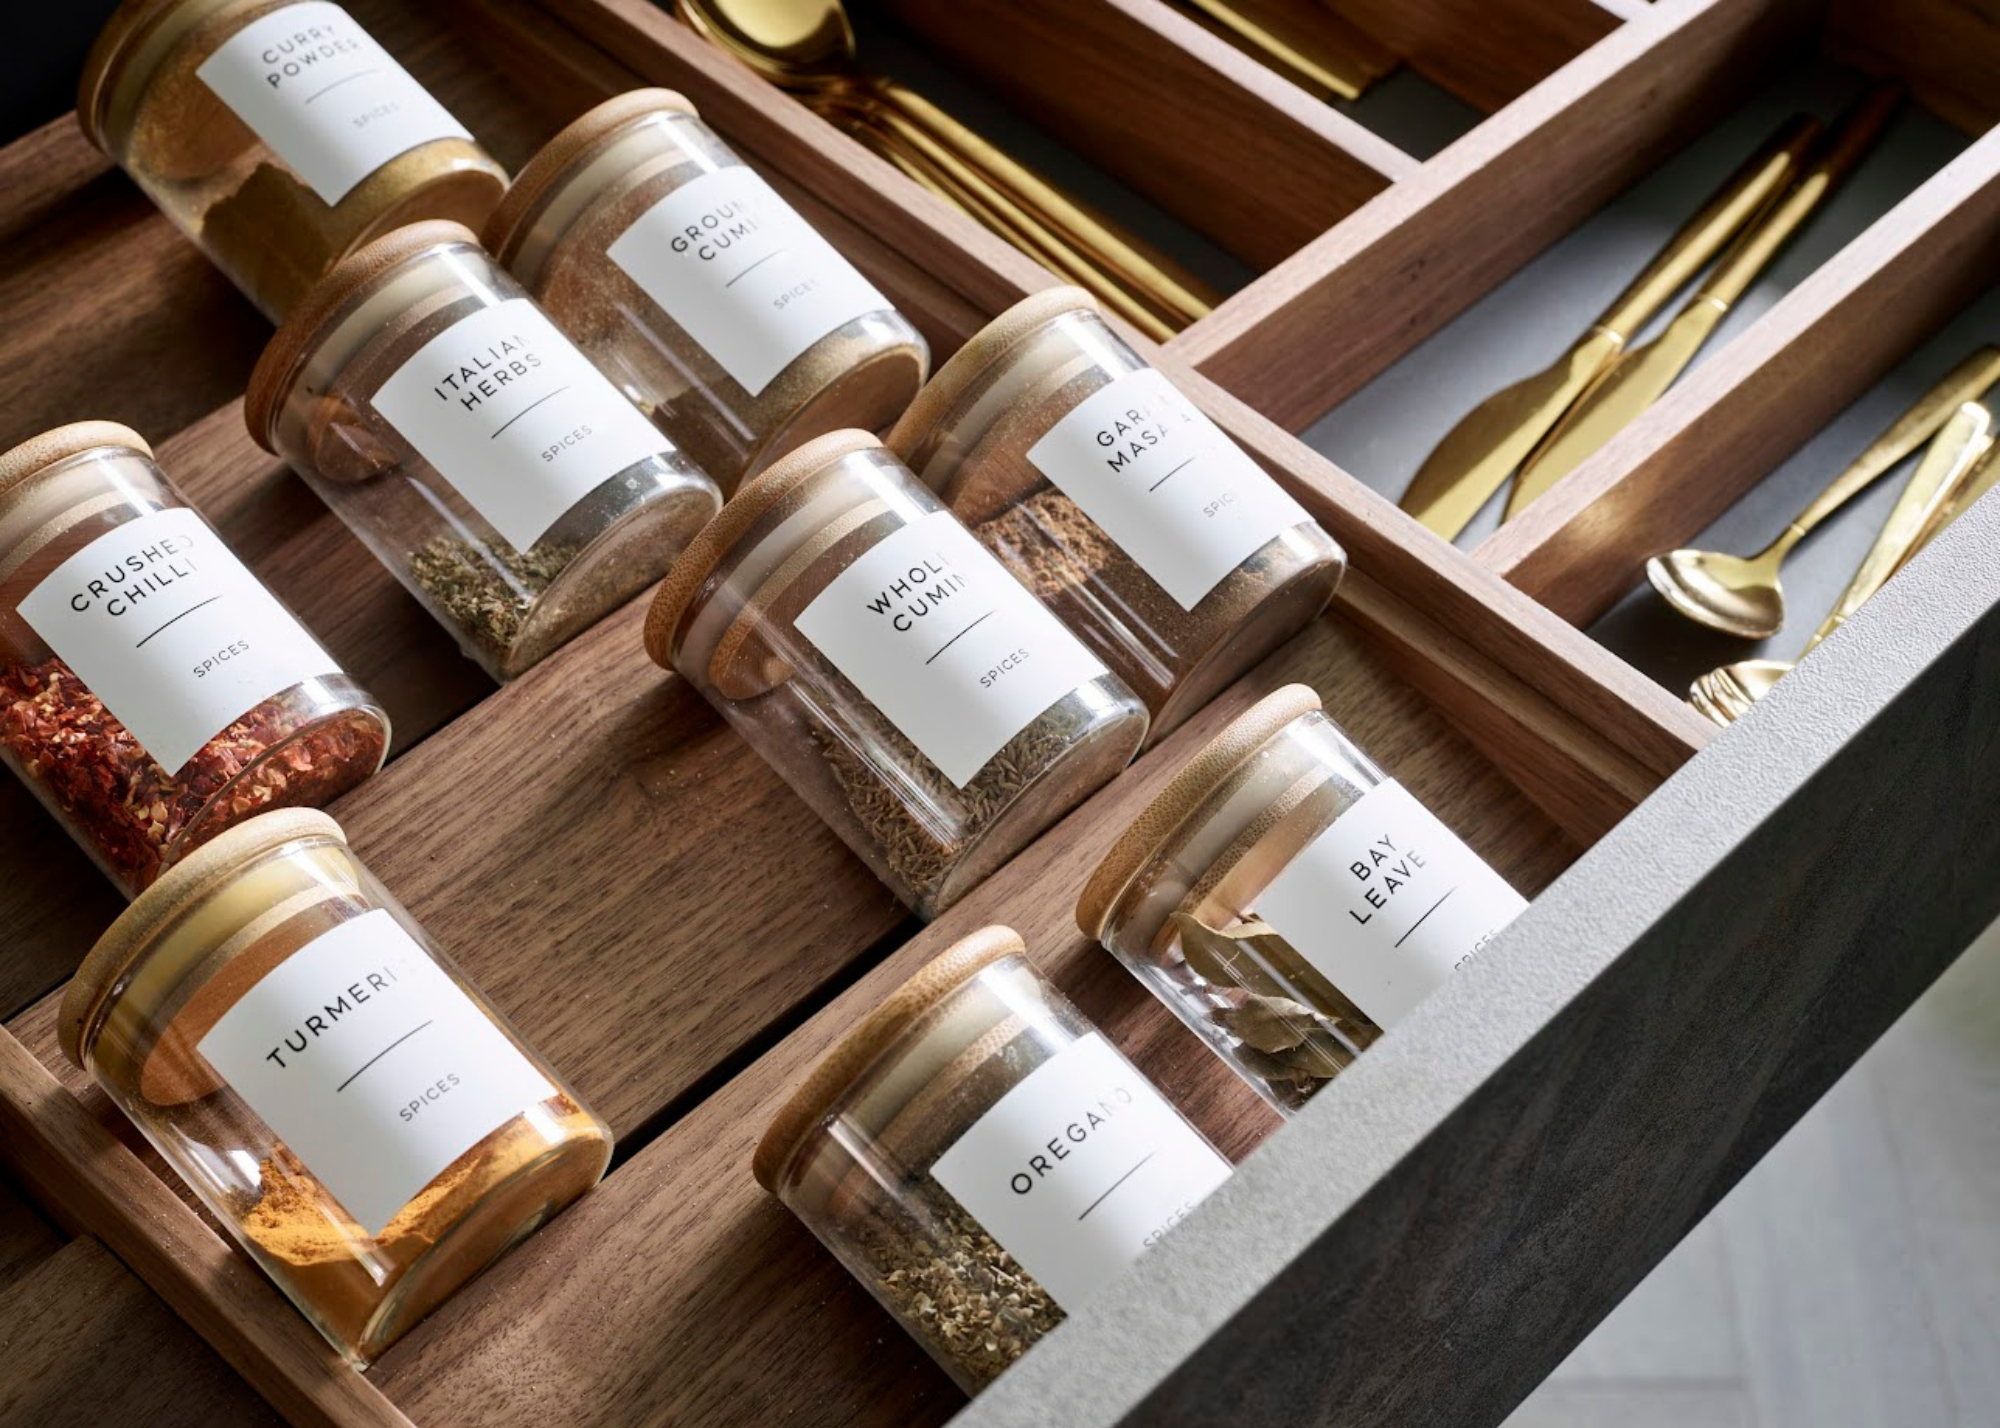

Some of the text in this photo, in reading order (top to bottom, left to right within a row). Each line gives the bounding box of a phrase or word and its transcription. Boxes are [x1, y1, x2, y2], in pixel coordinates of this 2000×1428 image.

[671, 201, 743, 253] GROU
[460, 353, 543, 412] HERBS
[540, 424, 593, 462] SPICES
[106, 558, 198, 617] CHILLI
[193, 640, 250, 678] SPICES
[979, 648, 1031, 688] SPICES
[1349, 834, 1397, 882] BAY
[399, 1072, 462, 1122] SPICES
